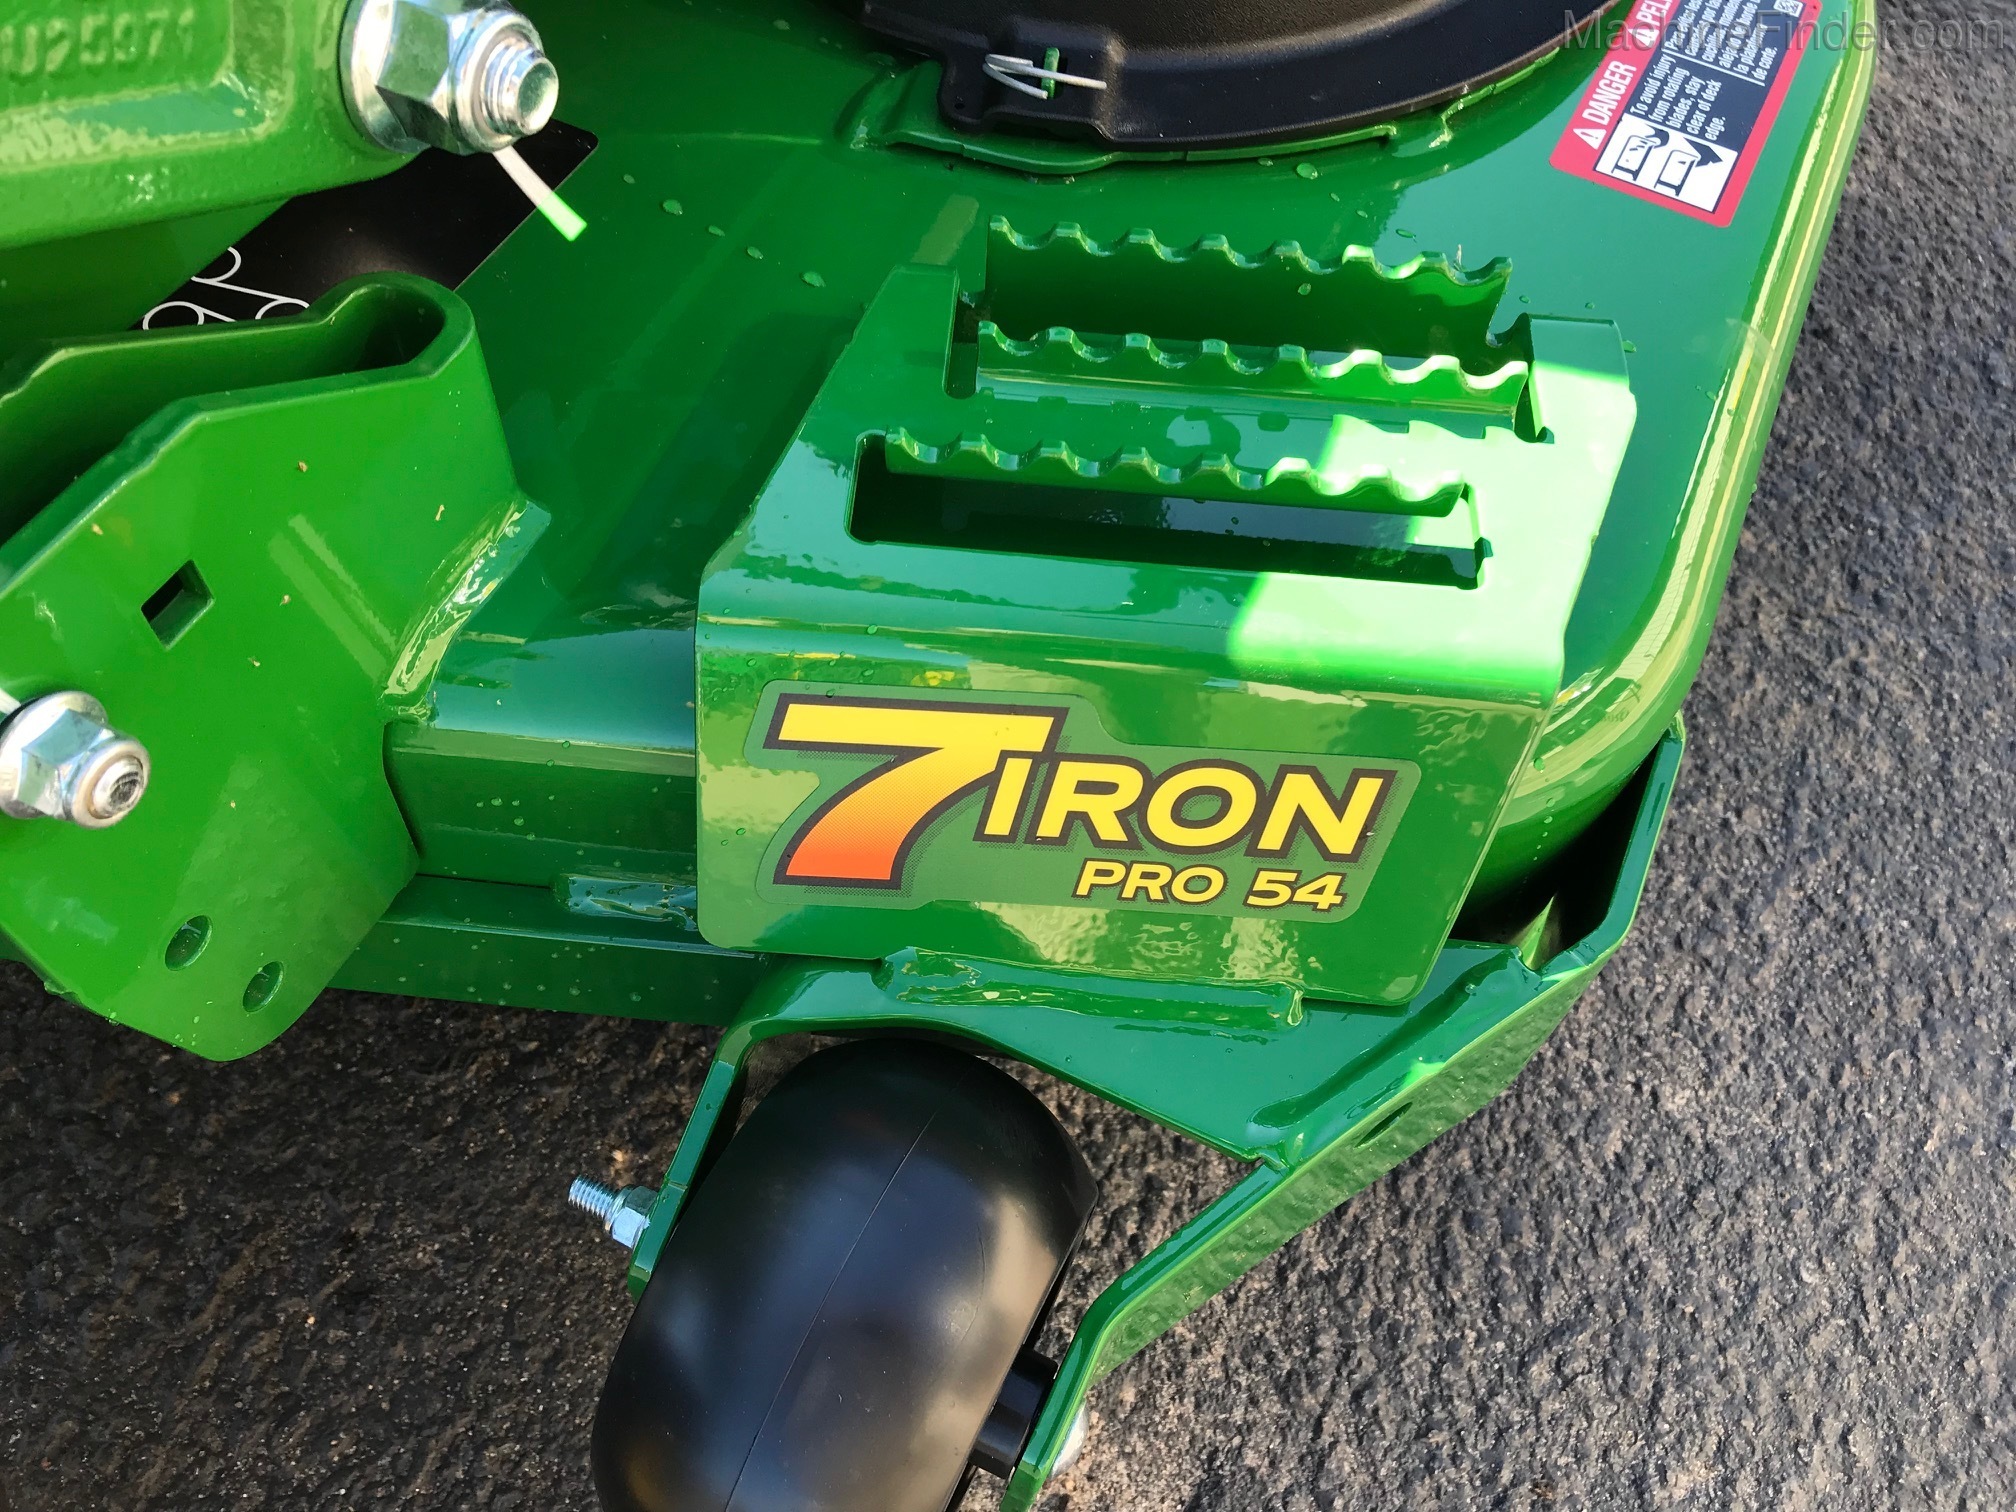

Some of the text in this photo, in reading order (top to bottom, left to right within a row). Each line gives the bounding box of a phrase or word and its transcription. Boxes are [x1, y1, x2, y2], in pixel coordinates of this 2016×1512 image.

[1636, 0, 1674, 26] PEL
[1701, 6, 1718, 23] por
[1736, 2, 1759, 26] borde
[1630, 53, 1676, 116] To avoid injury
[1733, 63, 1750, 75] la
[1751, 46, 1779, 81] de corte.
[1581, 60, 1637, 126] DANGER
[1648, 66, 1690, 123] from rotating
[1666, 75, 1706, 129] blades, stay
[1686, 79, 1721, 135] clear of deck
[1705, 116, 1727, 141] edge.
[765, 694, 1394, 888] 7 IRON
[1073, 862, 1343, 911] PRO 54
